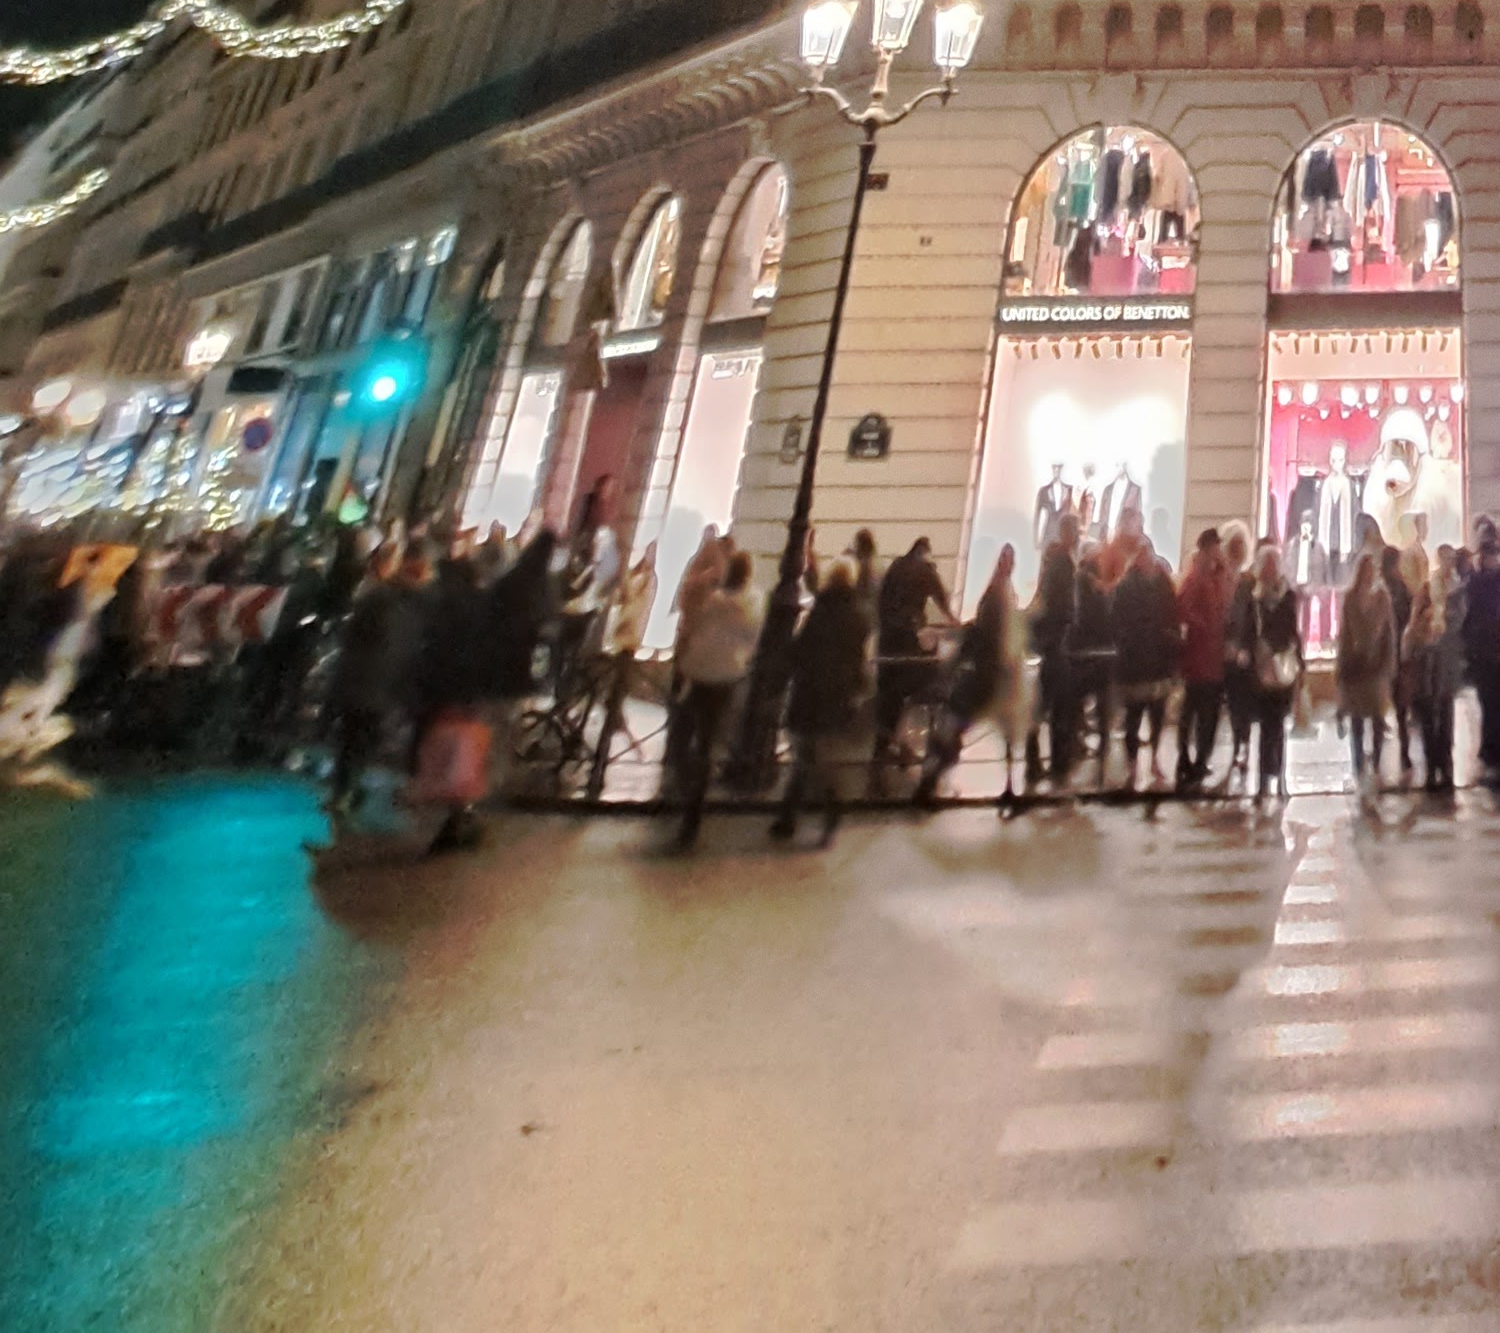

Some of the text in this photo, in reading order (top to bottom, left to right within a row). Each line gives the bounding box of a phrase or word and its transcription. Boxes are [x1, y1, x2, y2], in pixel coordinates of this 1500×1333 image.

[1002, 308, 1049, 322] UNITED
[1050, 307, 1102, 321] COLORS
[1103, 307, 1122, 321] OF
